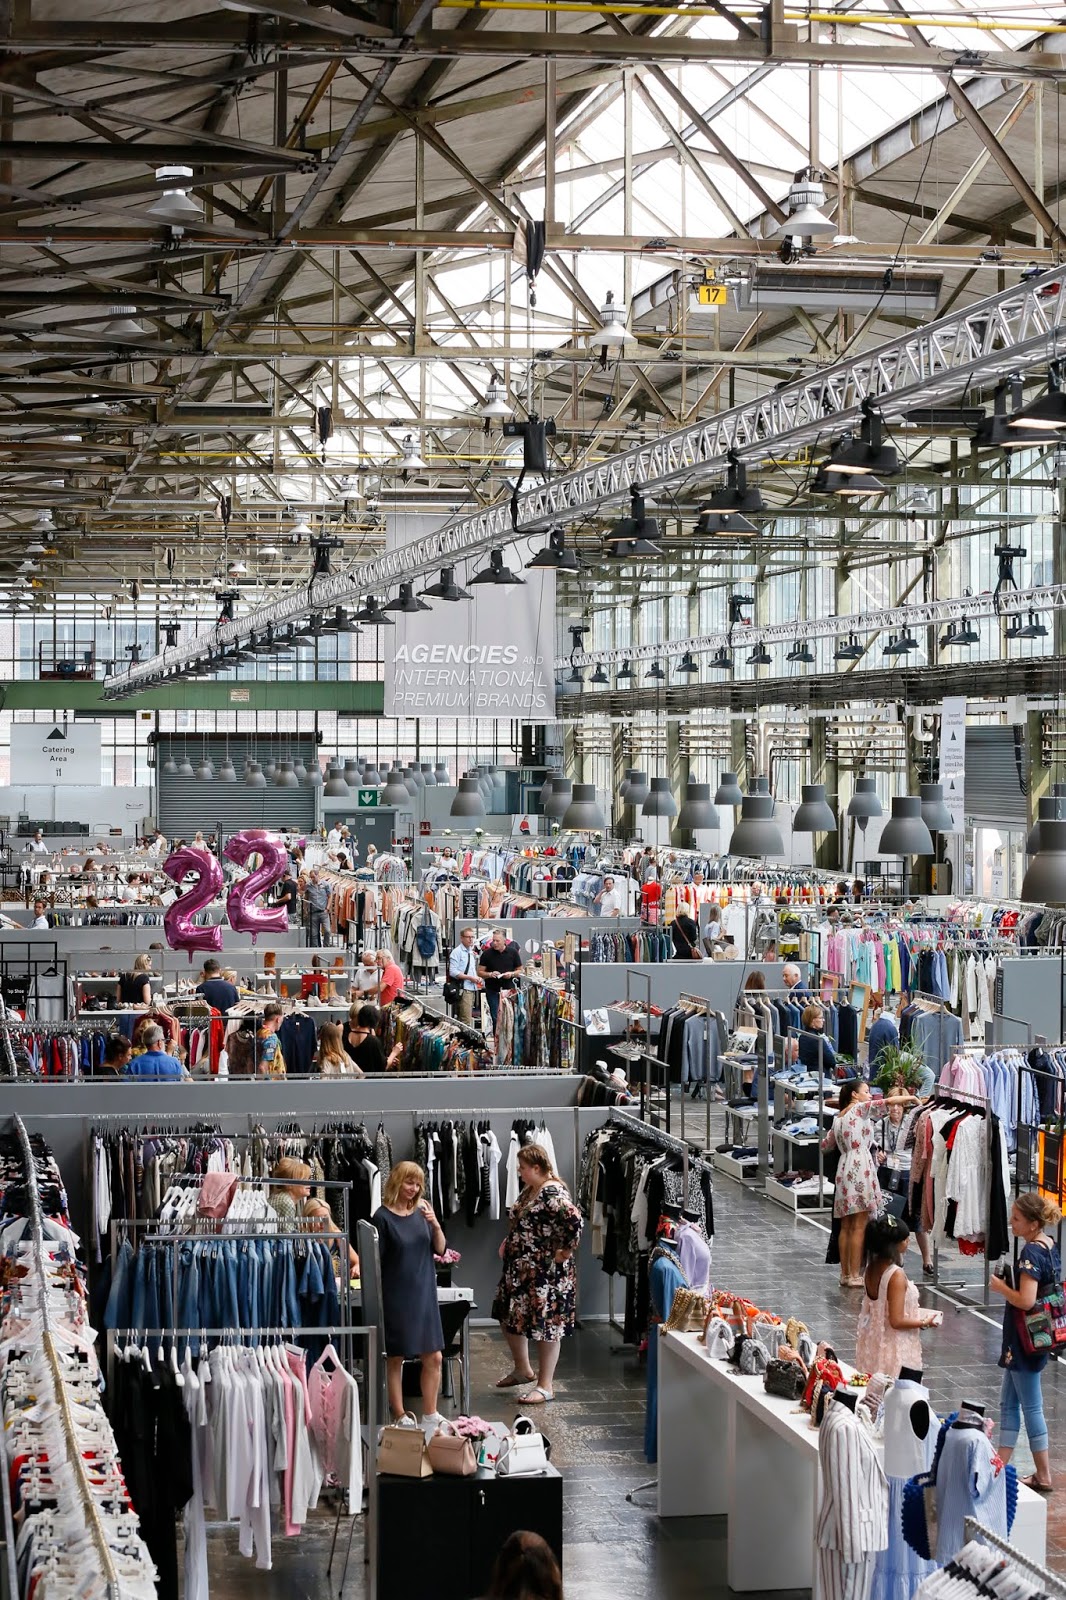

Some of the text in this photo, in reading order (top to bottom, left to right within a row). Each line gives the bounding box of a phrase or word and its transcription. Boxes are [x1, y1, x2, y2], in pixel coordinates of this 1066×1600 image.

[706, 288, 720, 302] 17
[393, 644, 544, 665] AGENCIES AND
[393, 669, 548, 687] INTERNATIONAL
[392, 692, 547, 708] PREMIUM BRANDS
[42, 746, 75, 754] Catering
